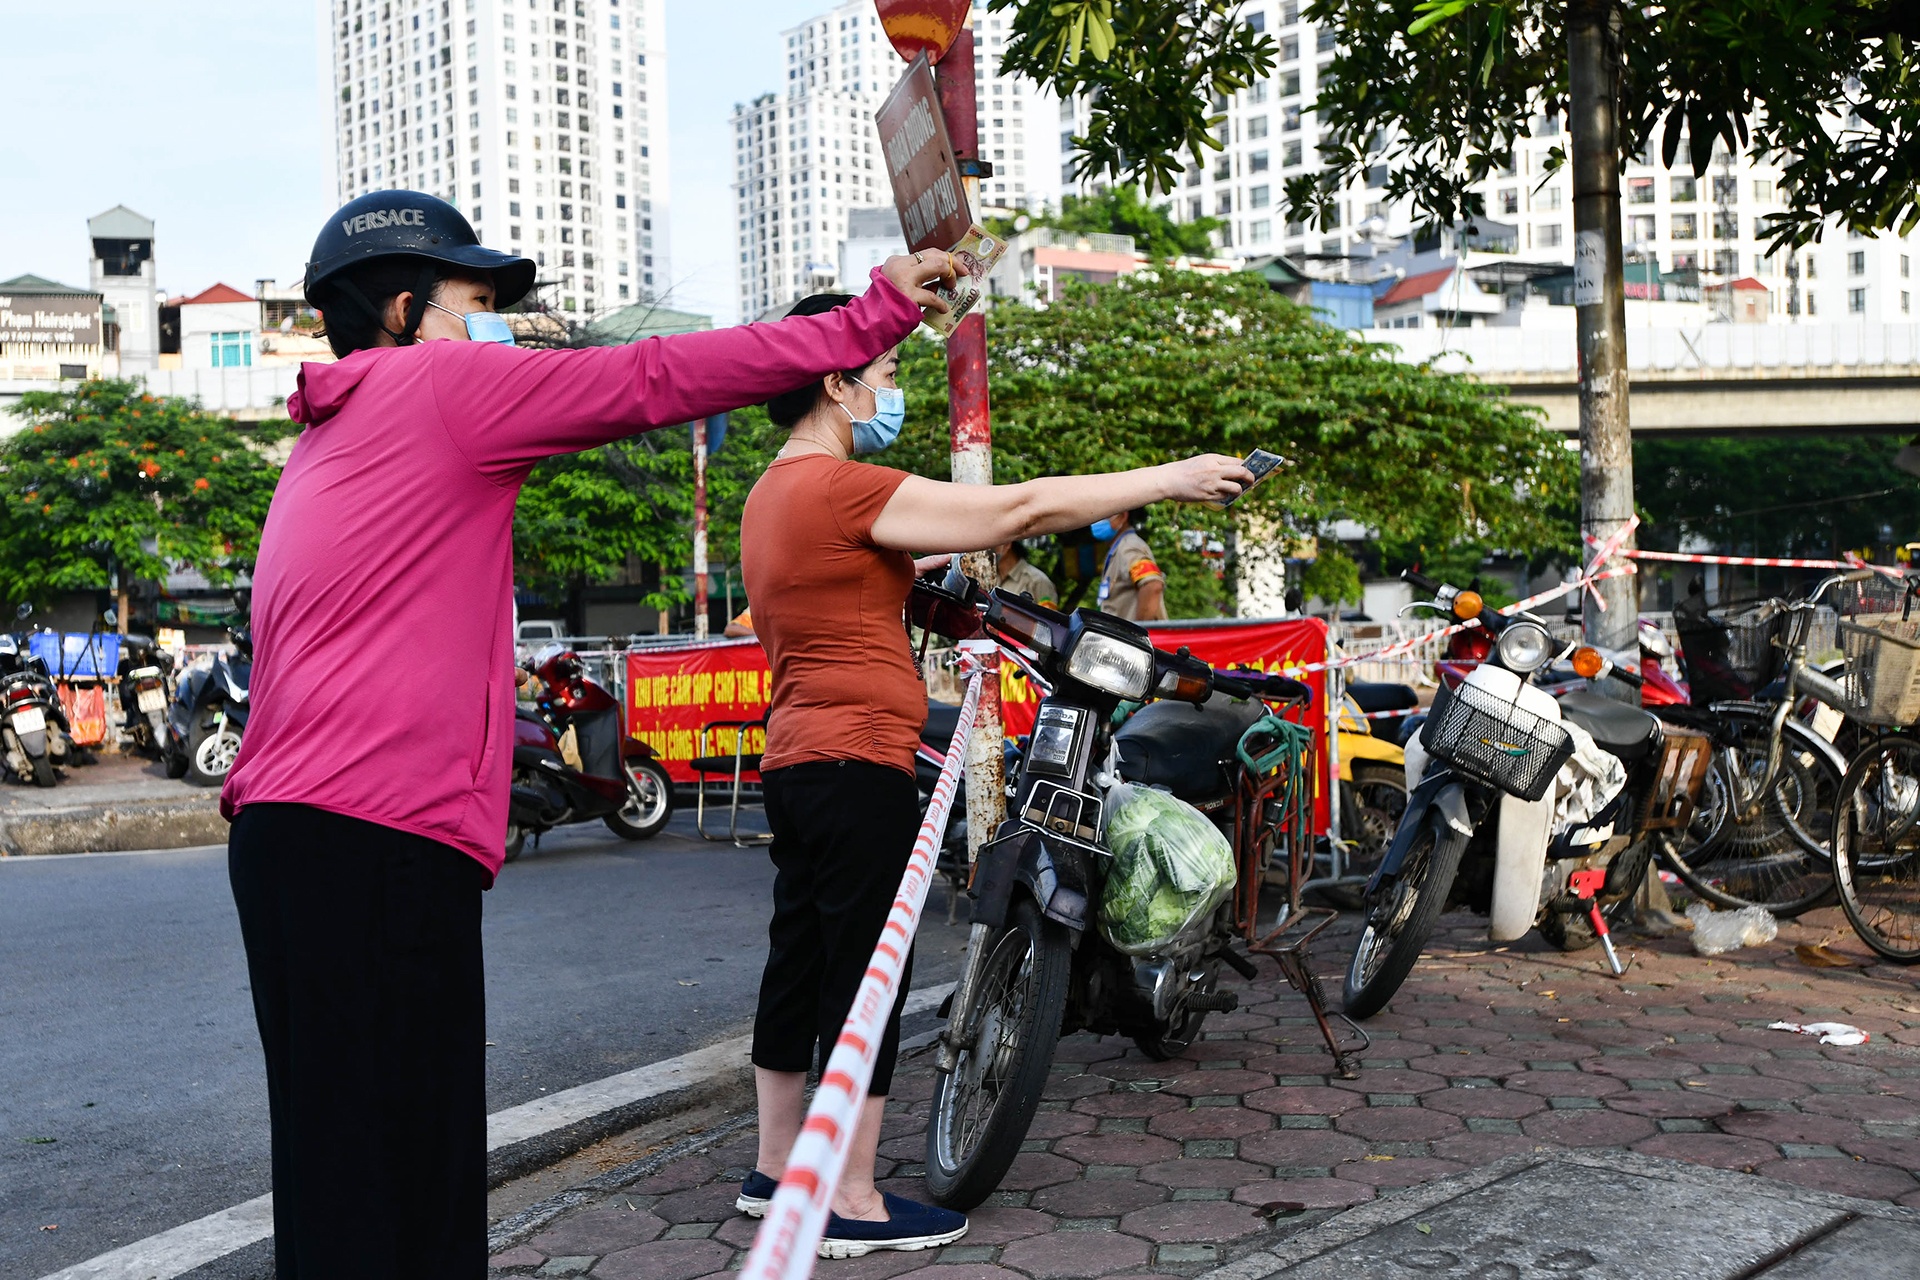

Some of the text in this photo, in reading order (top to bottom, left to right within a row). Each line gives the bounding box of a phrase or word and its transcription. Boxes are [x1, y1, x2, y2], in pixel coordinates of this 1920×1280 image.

[934, 166, 959, 220] CHỢ
[342, 208, 426, 237] VERSACE
[634, 676, 652, 709] KHU
[670, 663, 692, 706] CẤM
[692, 672, 713, 712] HỌP
[714, 668, 736, 711] CHỢ
[1042, 711, 1075, 720] HONDA
[667, 723, 694, 761] CÔNG
